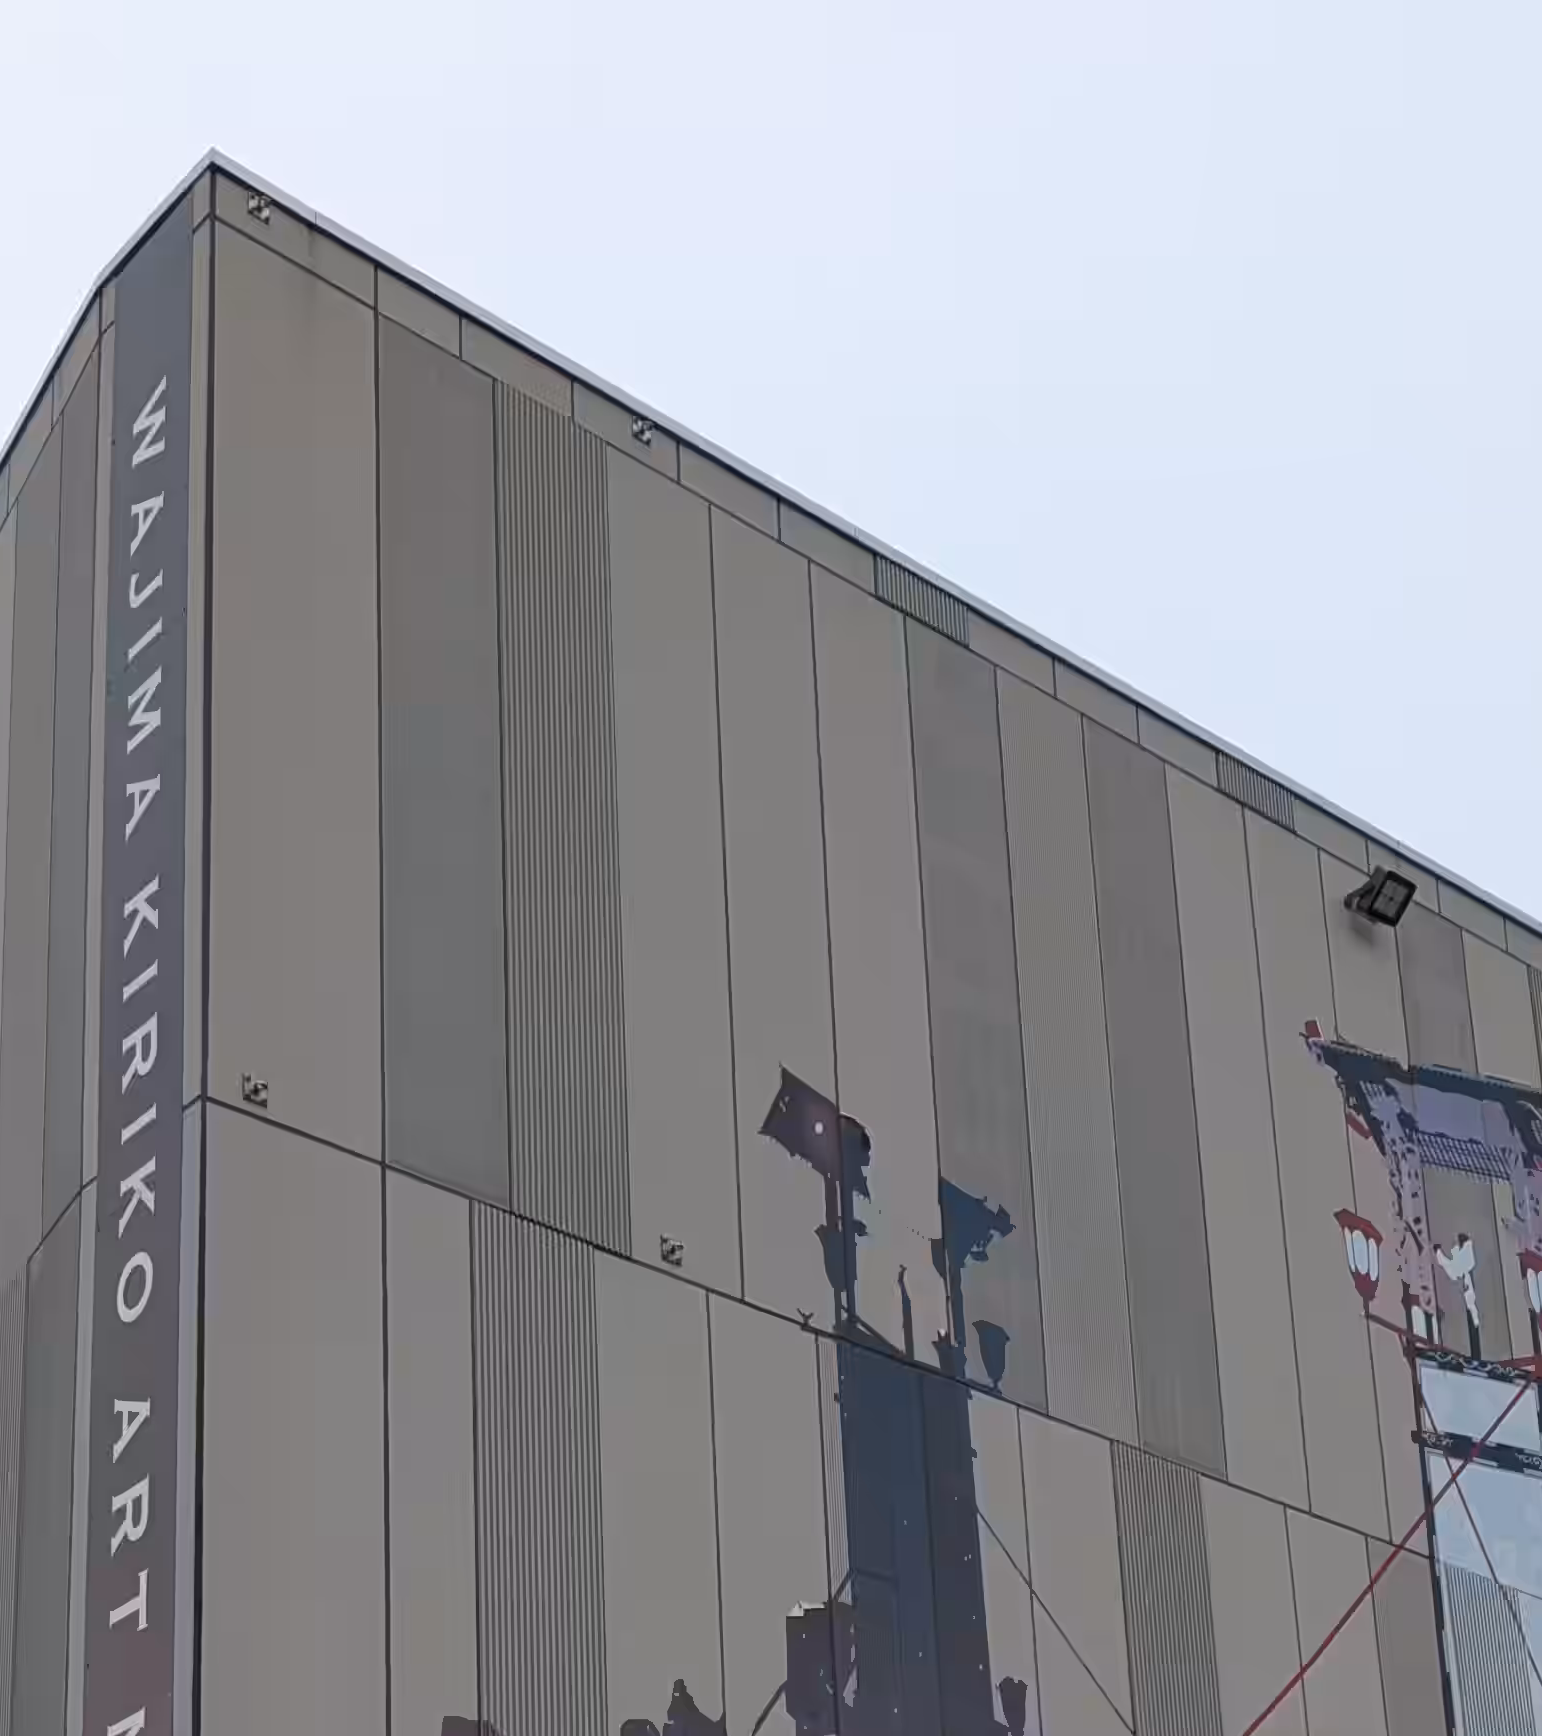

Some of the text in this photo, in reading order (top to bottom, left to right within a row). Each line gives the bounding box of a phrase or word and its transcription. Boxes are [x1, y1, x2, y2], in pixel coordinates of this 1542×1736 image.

[125, 374, 167, 843] WAJIMA
[115, 873, 159, 1323] KIRIKO
[109, 1397, 151, 1632] ART
